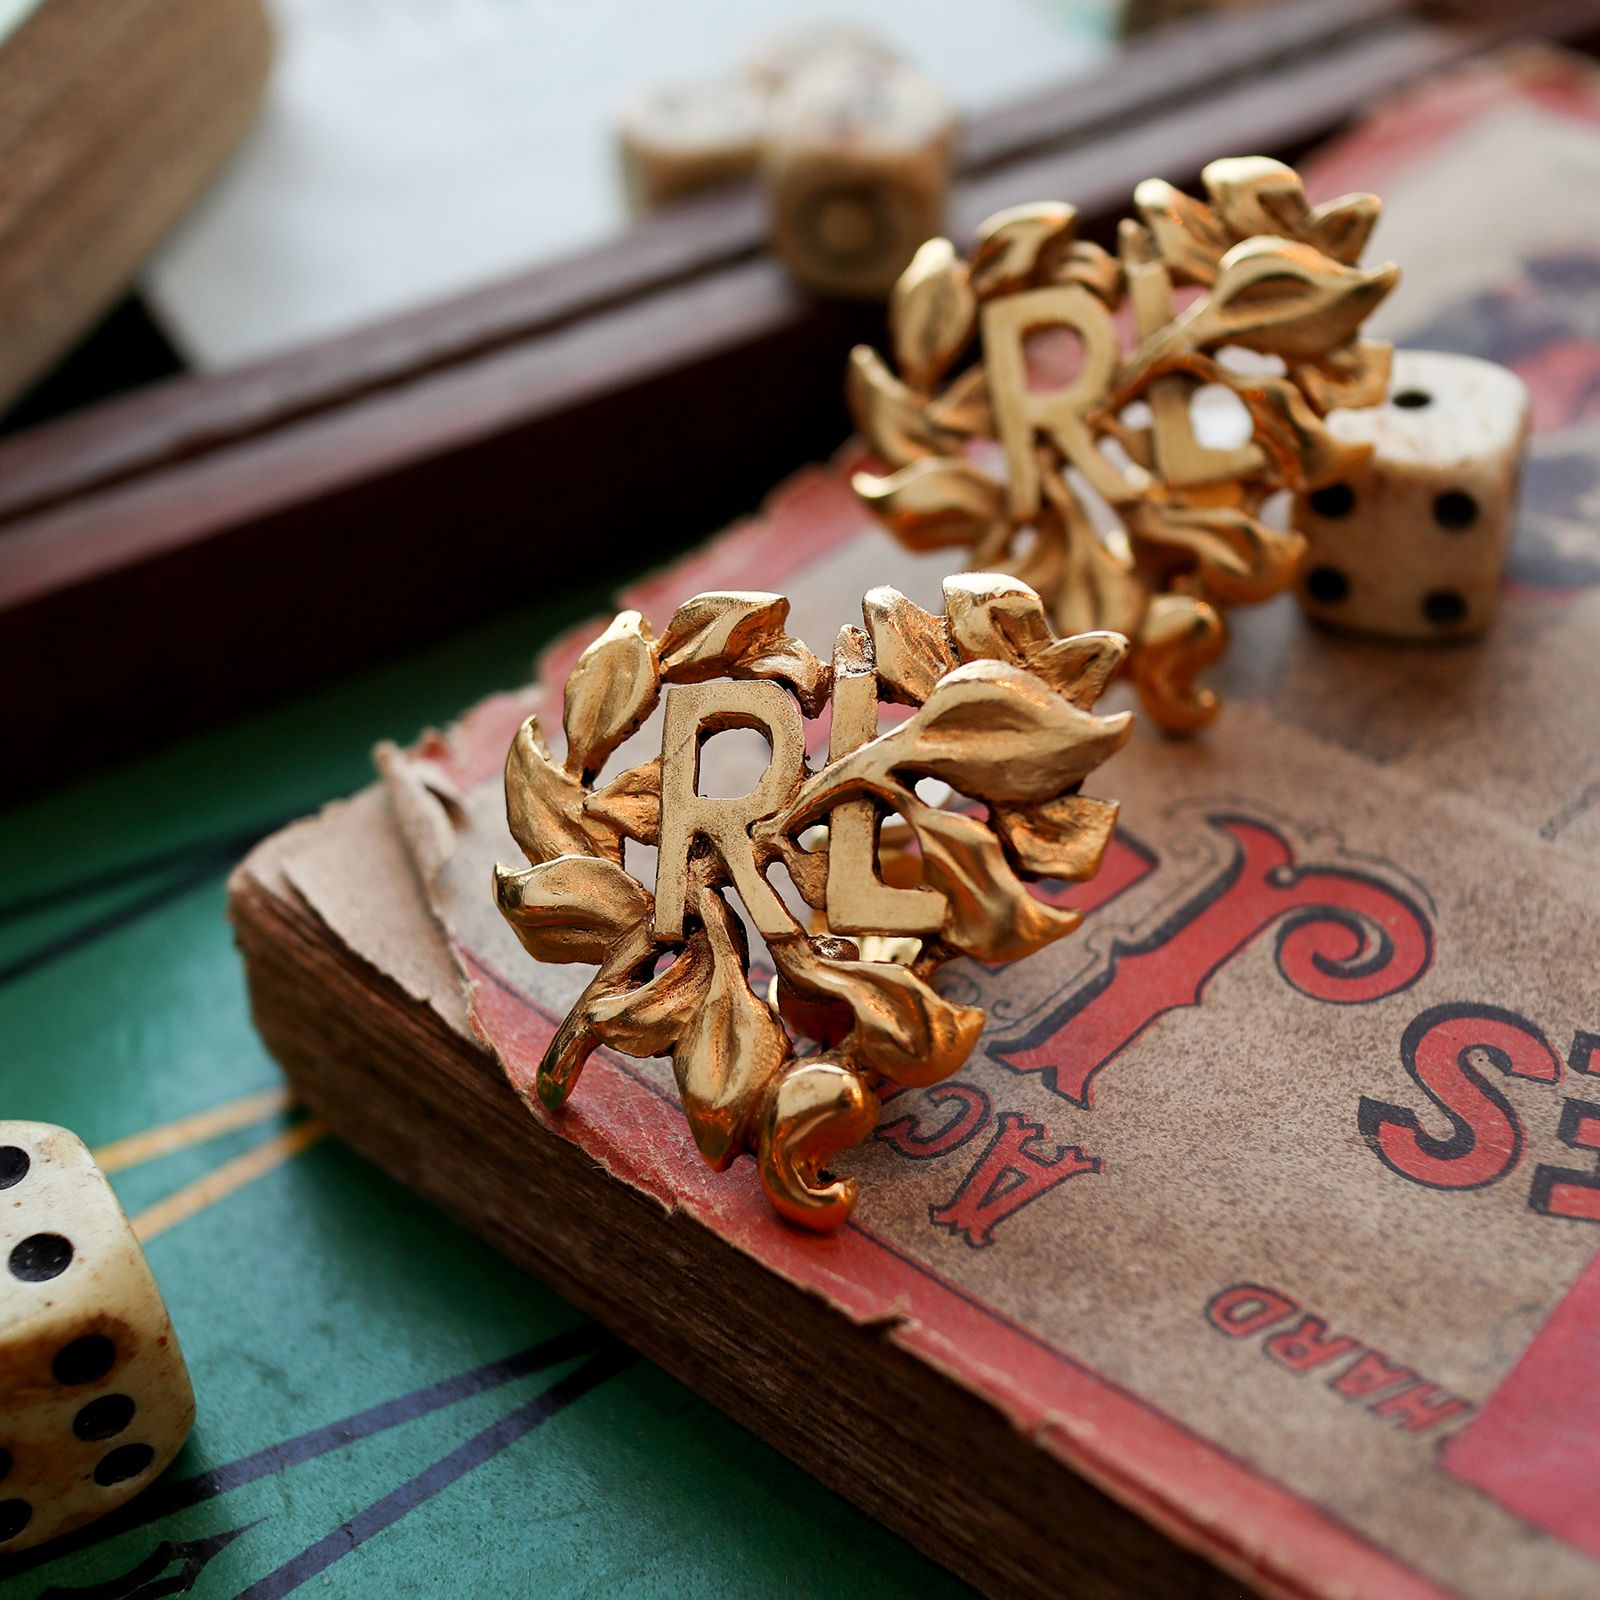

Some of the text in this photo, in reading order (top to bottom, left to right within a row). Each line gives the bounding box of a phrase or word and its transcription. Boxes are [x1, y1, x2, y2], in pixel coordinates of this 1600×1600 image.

[653, 625, 949, 943] RL
[872, 1078, 1105, 1248] AC
[1204, 1281, 1476, 1436] HARD
